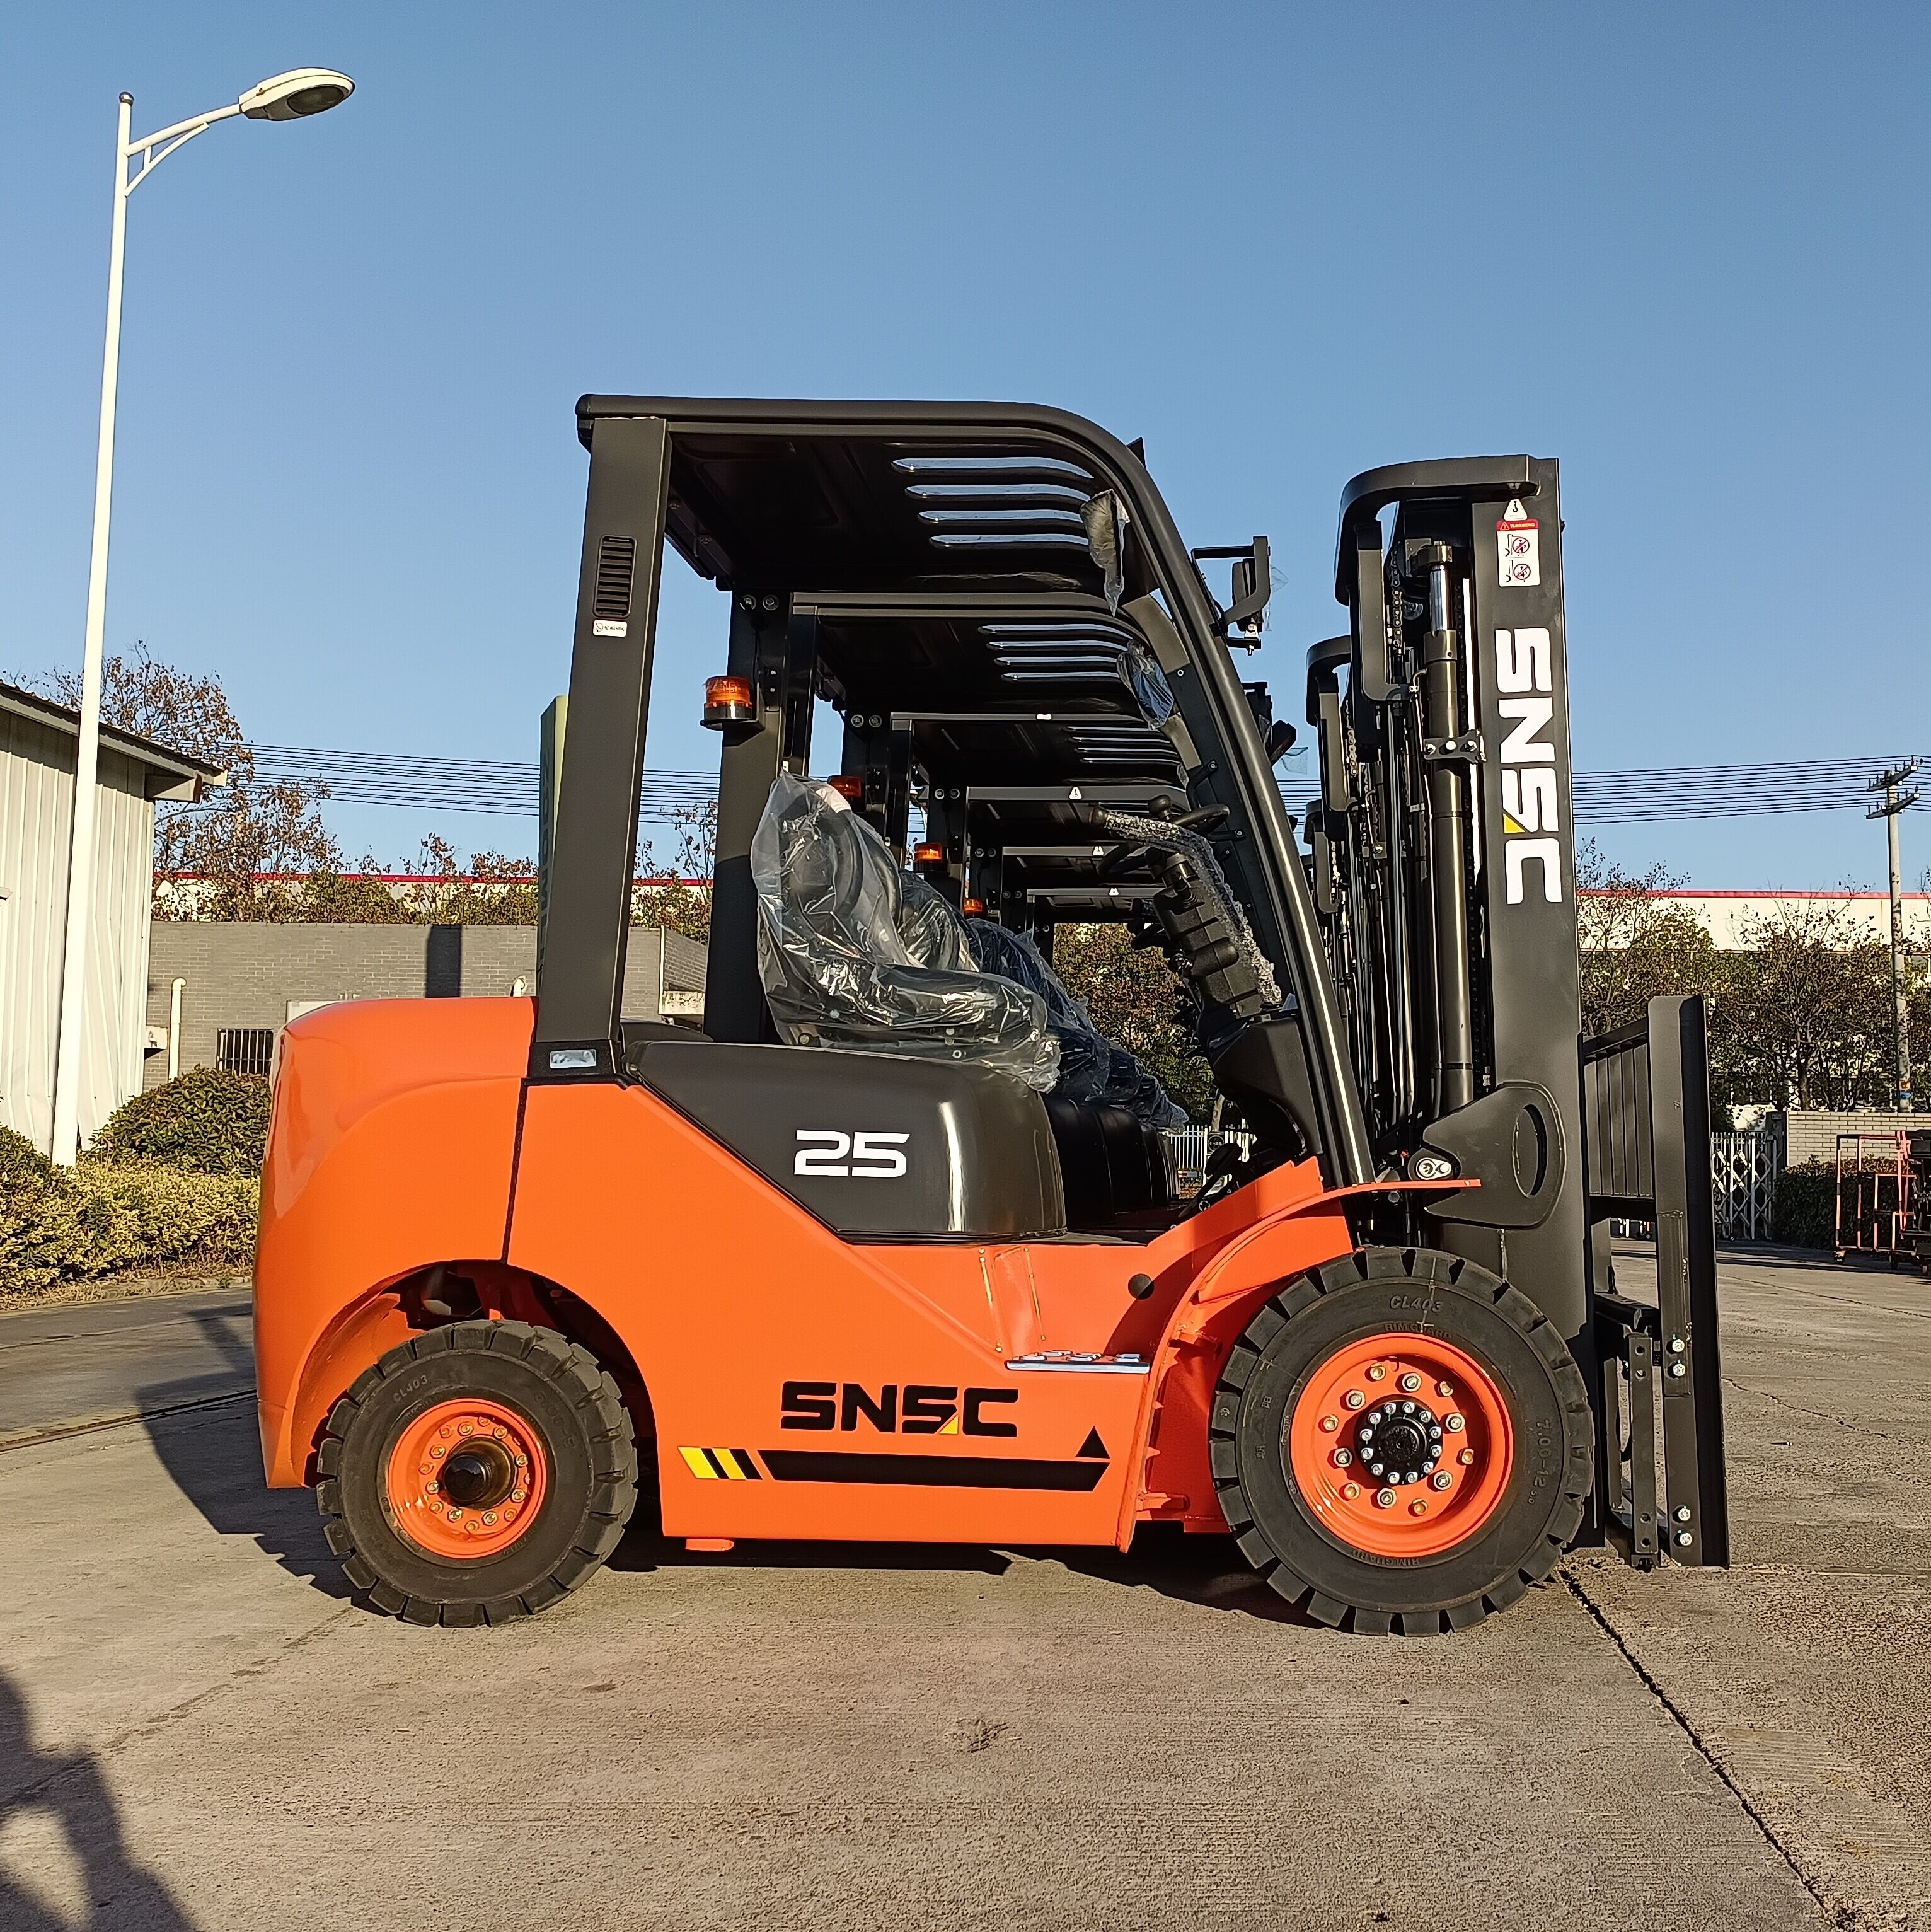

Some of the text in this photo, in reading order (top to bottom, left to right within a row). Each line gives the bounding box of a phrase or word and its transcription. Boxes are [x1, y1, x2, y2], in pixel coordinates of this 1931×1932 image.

[1495, 627, 1562, 904] SNSC
[794, 1130, 910, 1177] 25
[1390, 1295, 1443, 1312] CL403
[1385, 1323, 1407, 1331] RIM
[393, 1375, 427, 1401] CL403
[780, 1380, 1018, 1437] SNSC
[1534, 1420, 1552, 1487] 7.00-12
[1351, 1550, 1421, 1566] RIM GUARD
